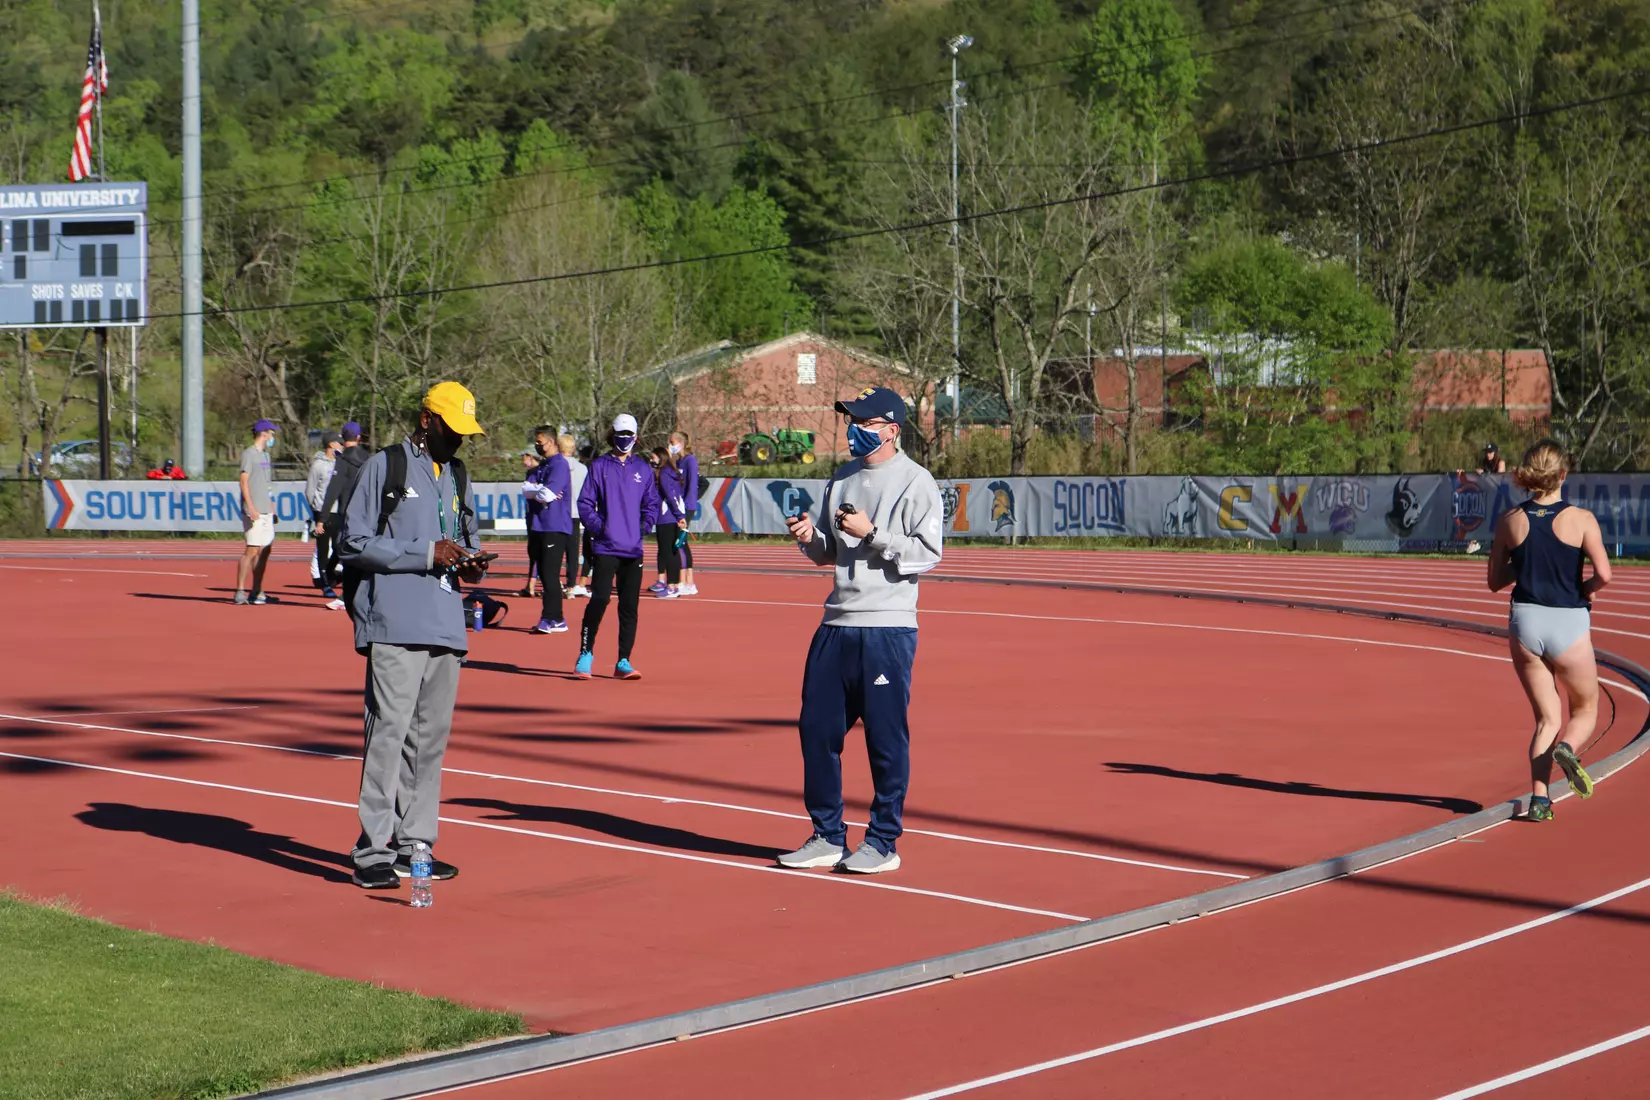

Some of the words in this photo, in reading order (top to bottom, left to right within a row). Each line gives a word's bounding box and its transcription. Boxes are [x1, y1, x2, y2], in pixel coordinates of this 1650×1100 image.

[41, 189, 140, 208] UNIVERSITY
[31, 284, 64, 300] SHOTS
[71, 284, 103, 299] SAVES
[86, 491, 244, 521] SOUTHERN
[270, 491, 315, 521] ON
[783, 487, 800, 517] C
[1054, 479, 1126, 533] SOCON
[1216, 484, 1253, 531] C
[1316, 481, 1370, 514] WCU
